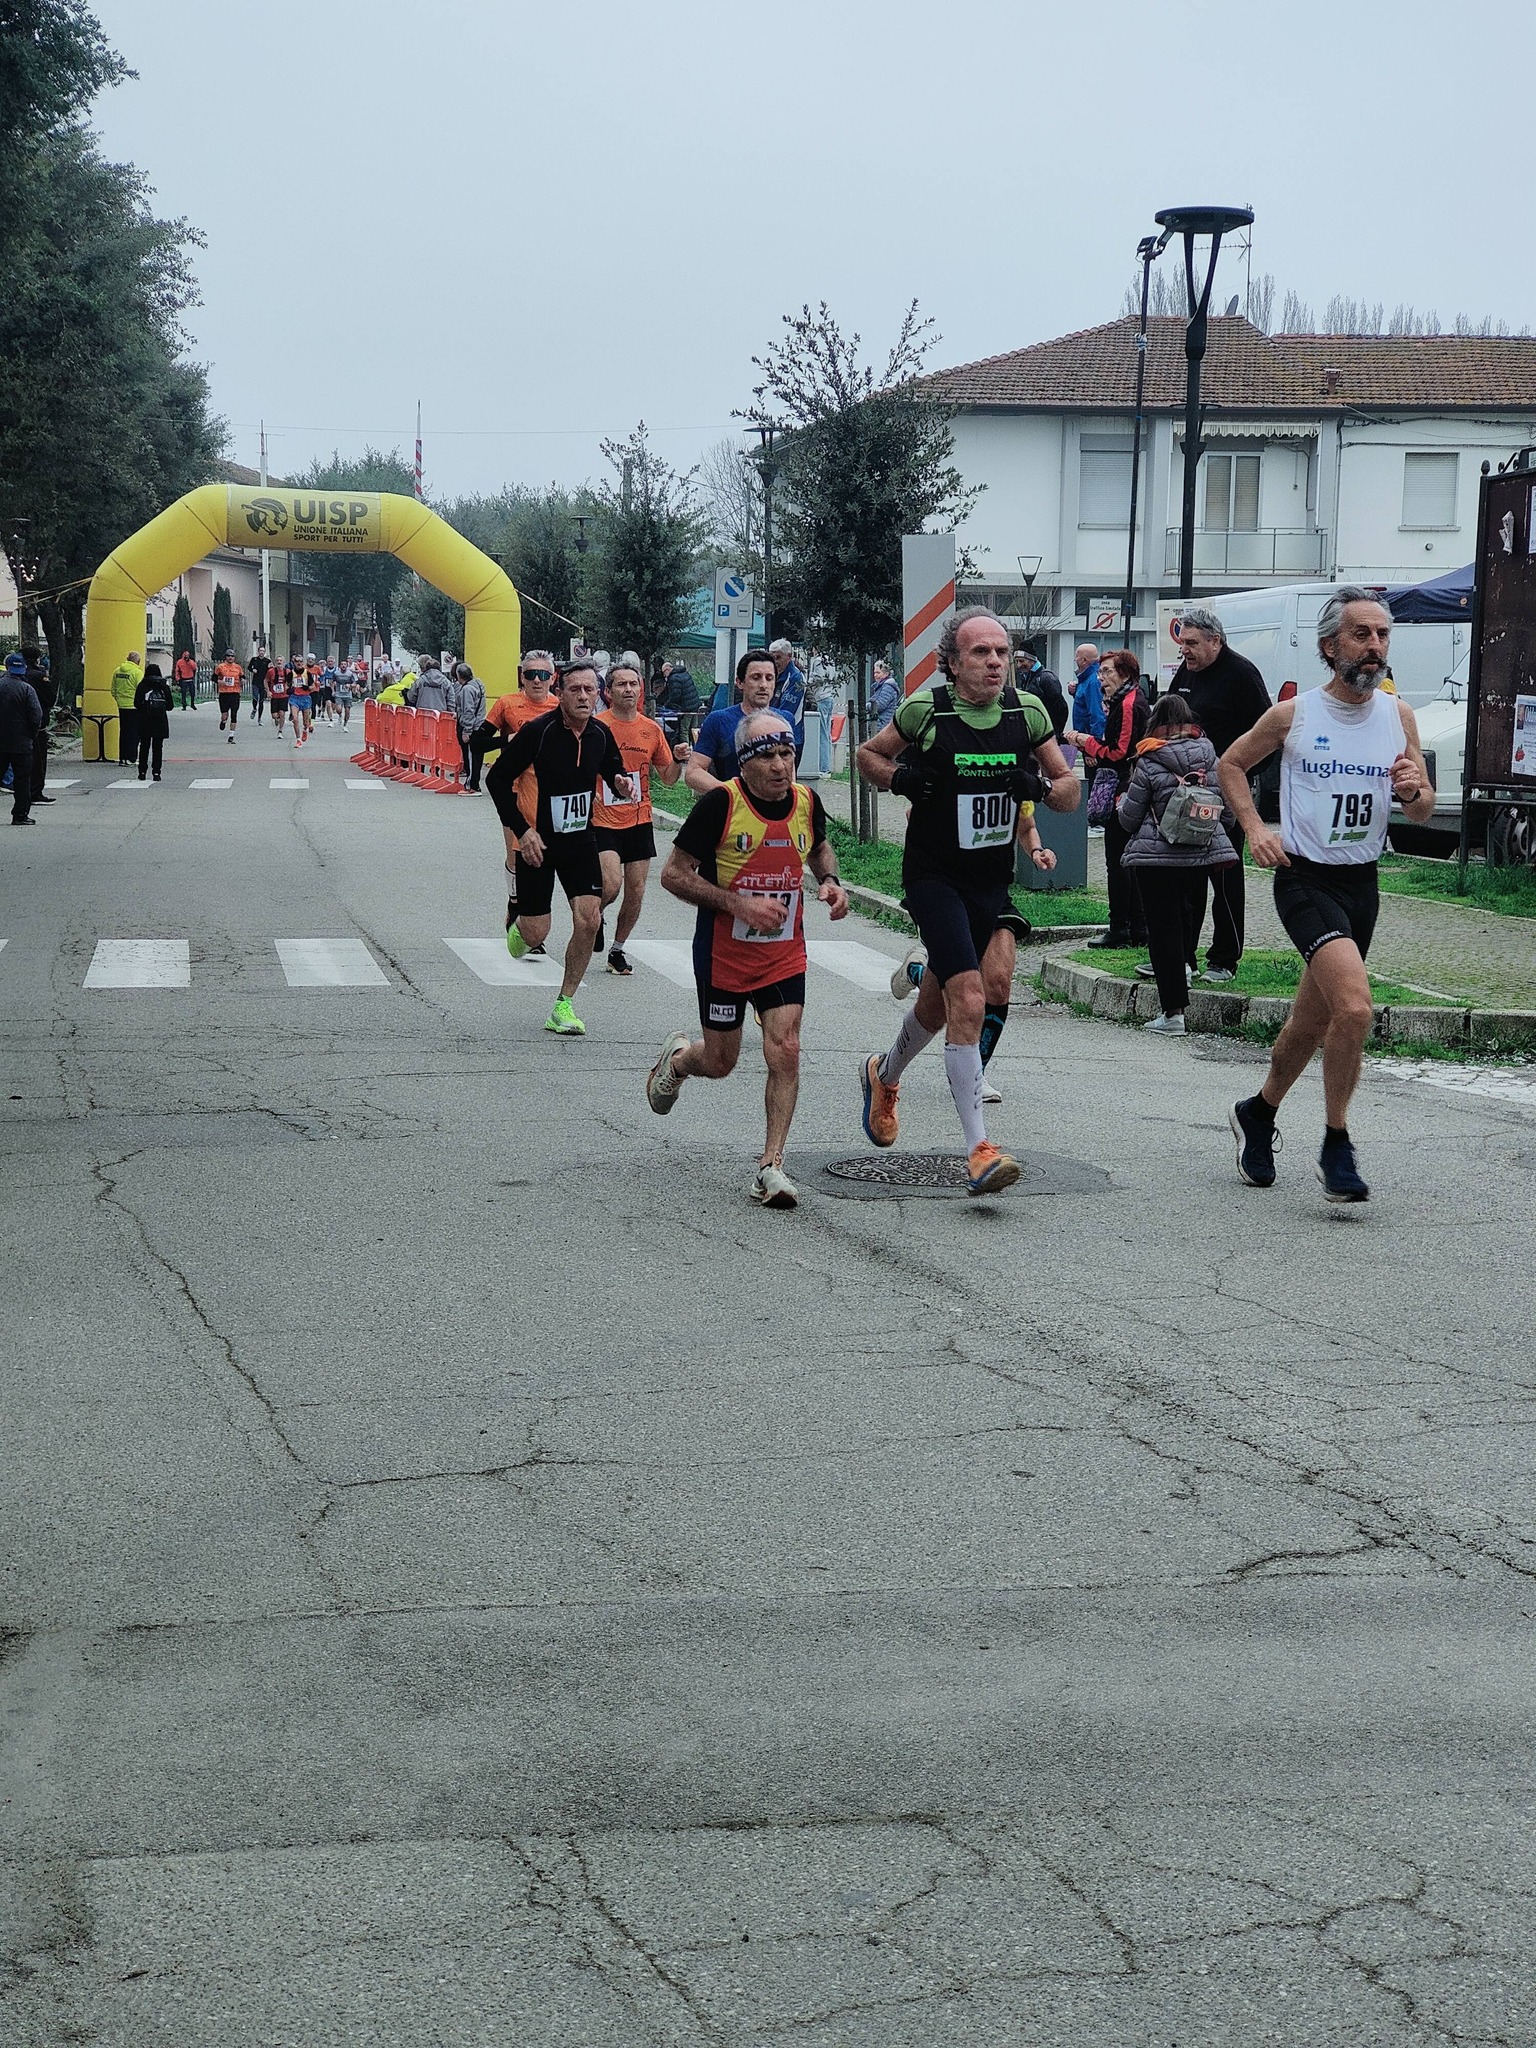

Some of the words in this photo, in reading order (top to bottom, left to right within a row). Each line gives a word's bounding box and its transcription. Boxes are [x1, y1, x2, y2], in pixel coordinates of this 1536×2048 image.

[293, 499, 368, 526] UISP
[293, 525, 326, 535] UNIONE
[330, 527, 368, 536] ITALIANA
[293, 533, 320, 542] SPORT
[323, 535, 338, 543] PER
[341, 536, 364, 544] TUTTI
[619, 741, 649, 754] Lamone
[1302, 758, 1389, 779] lughesina
[561, 793, 587, 820] 740
[972, 794, 1012, 830] 800
[1331, 793, 1374, 829] 793
